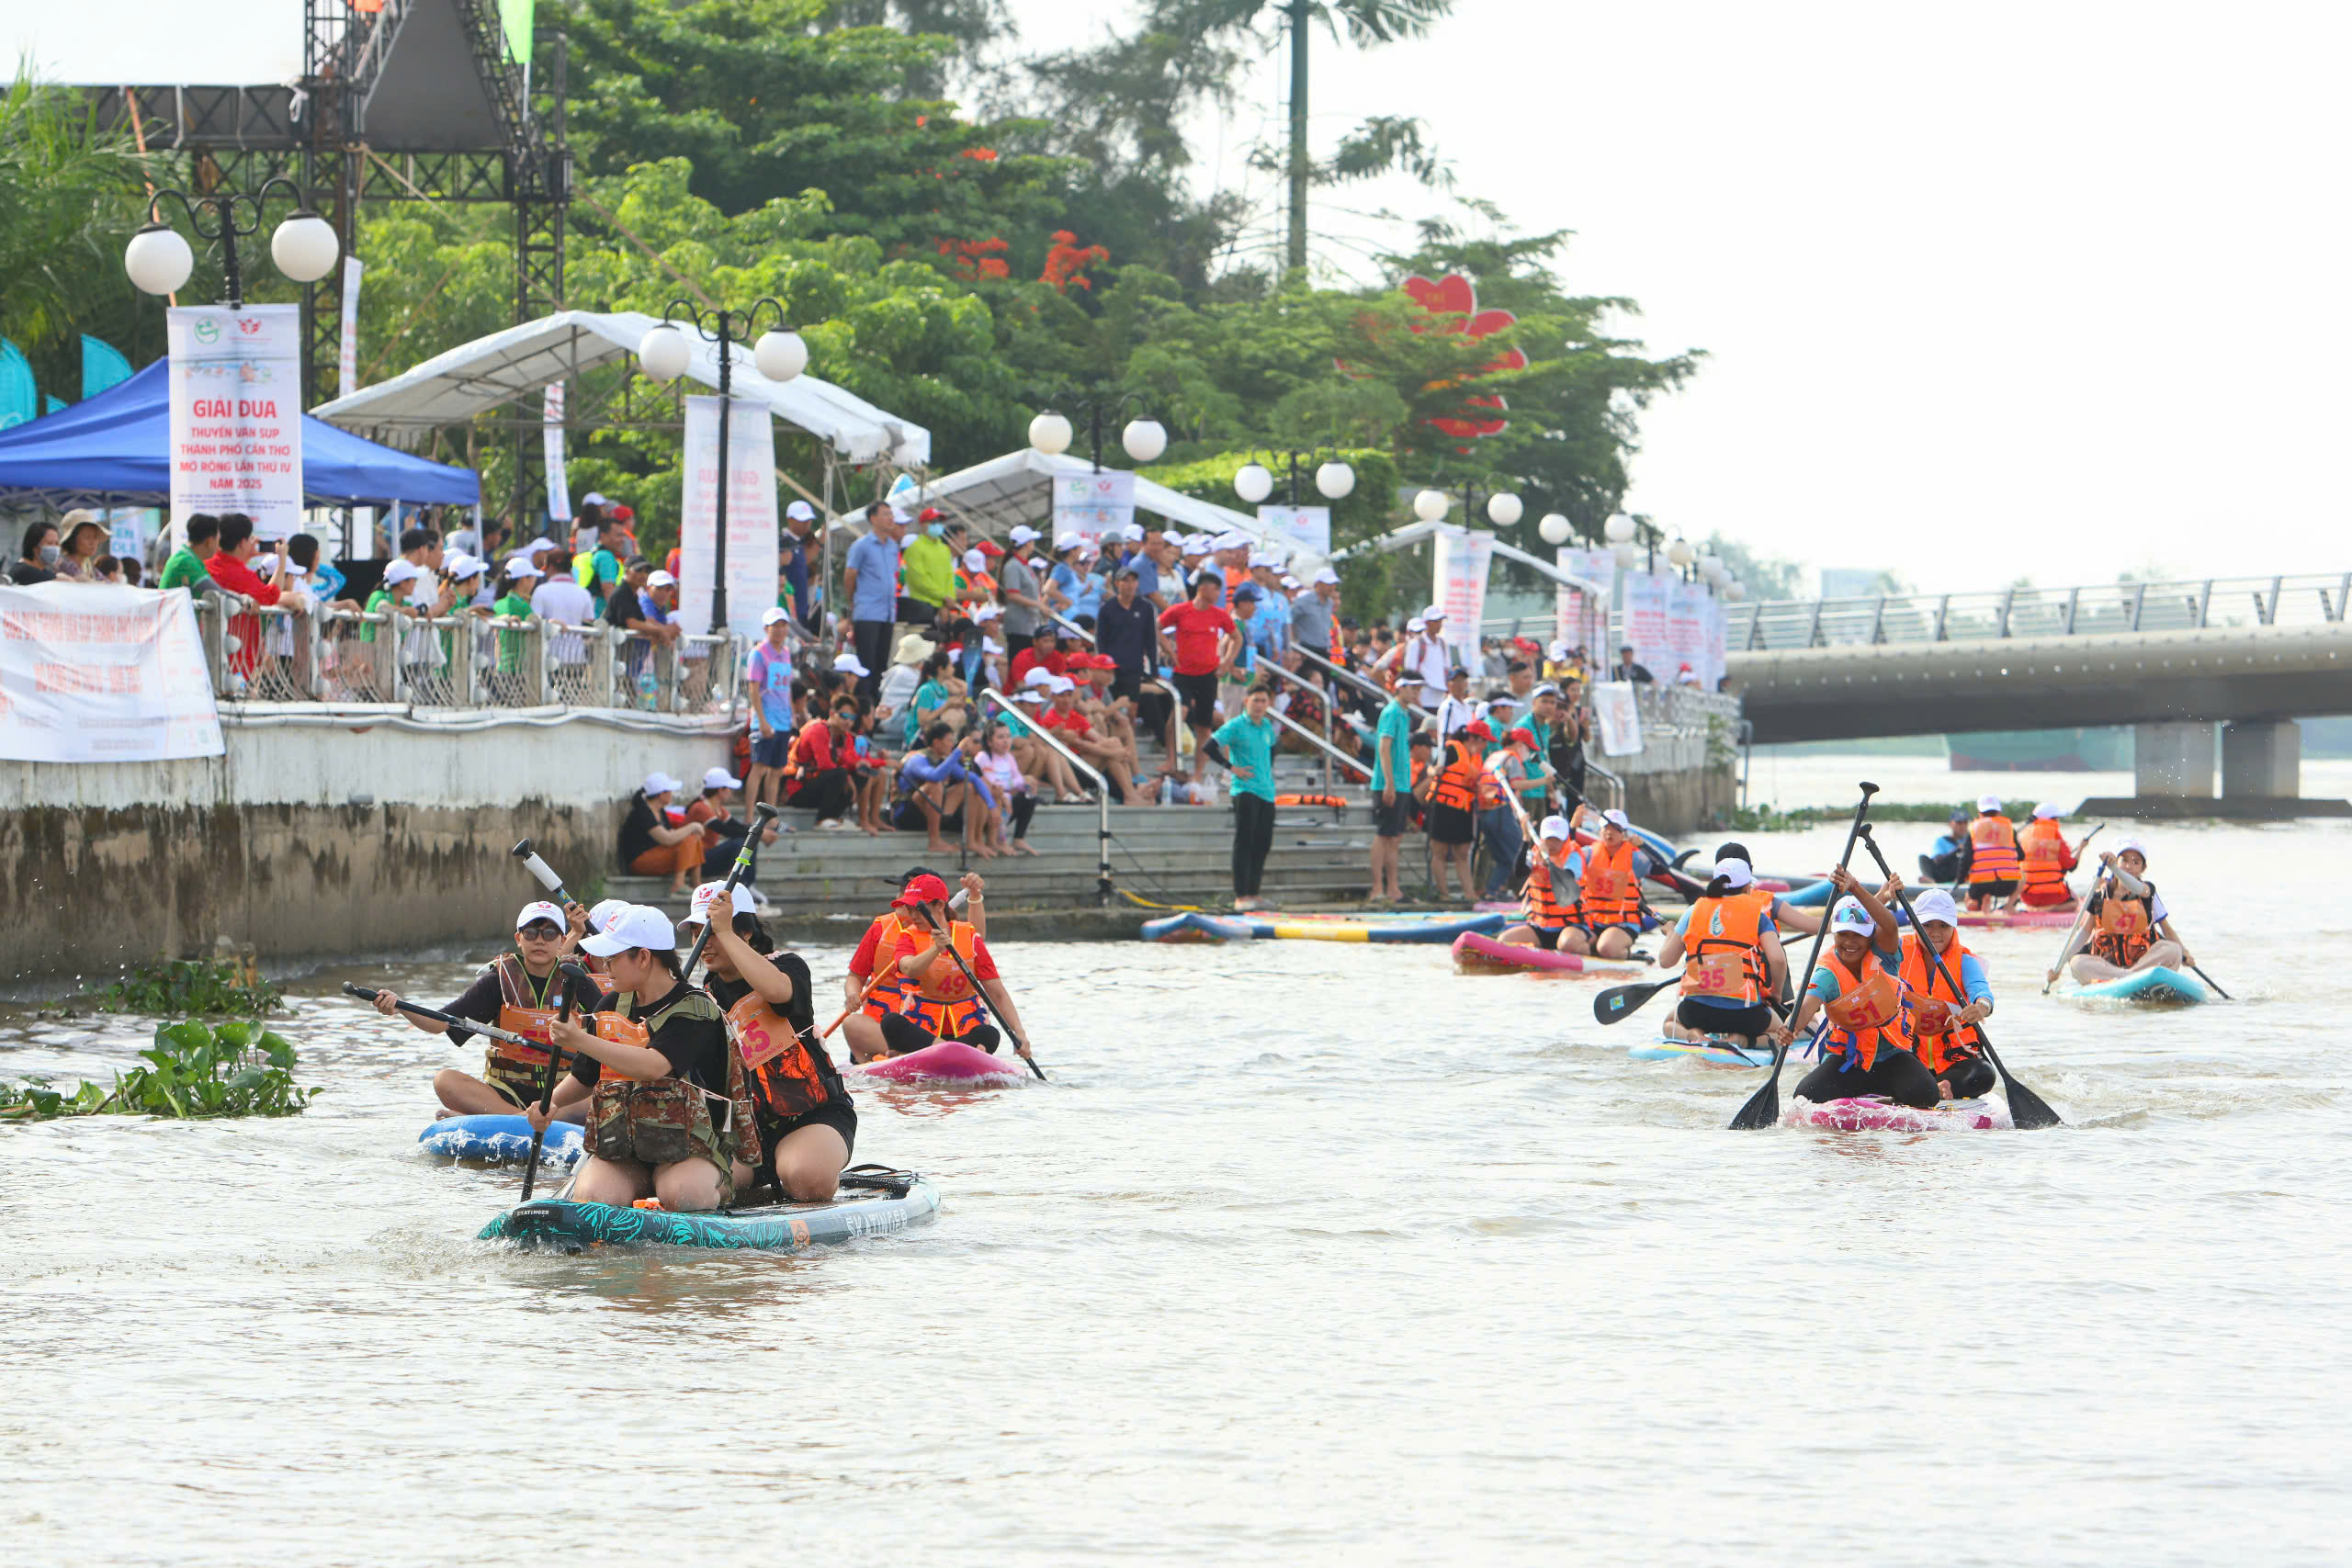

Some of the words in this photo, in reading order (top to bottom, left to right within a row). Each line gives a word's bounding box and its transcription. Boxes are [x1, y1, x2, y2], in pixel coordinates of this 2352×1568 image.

[259, 427, 280, 438] SUP
[237, 479, 263, 490] 2025
[2116, 913, 2138, 930] 47
[936, 975, 967, 994] 49
[1698, 968, 1725, 989] 35
[1849, 1000, 1882, 1026] 51
[1920, 1012, 1948, 1032] 51
